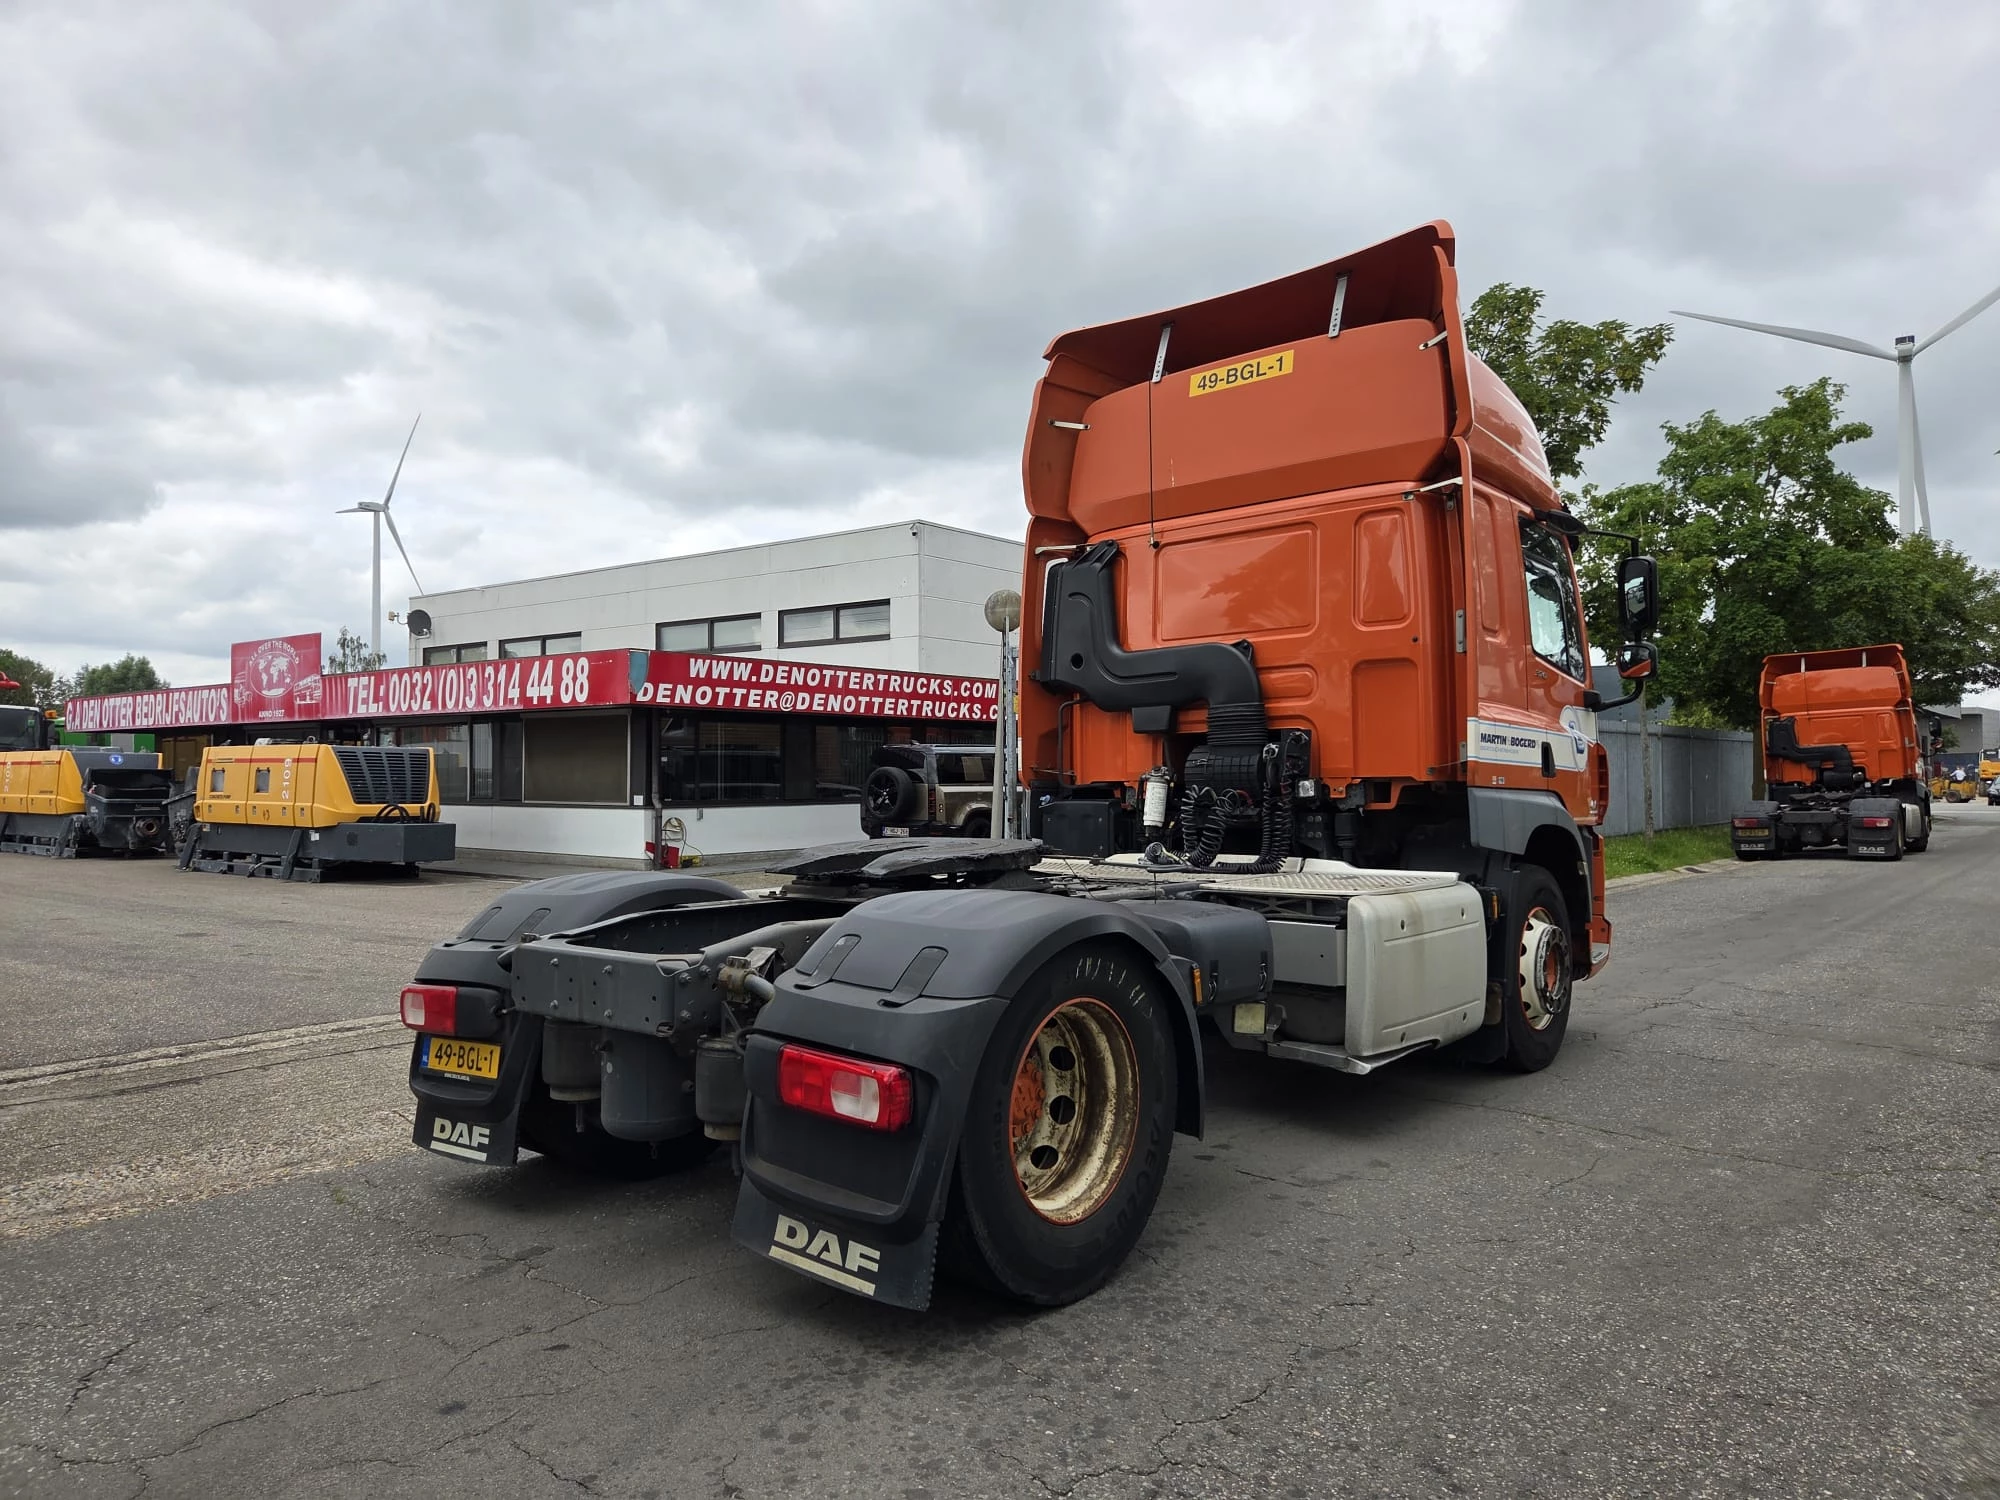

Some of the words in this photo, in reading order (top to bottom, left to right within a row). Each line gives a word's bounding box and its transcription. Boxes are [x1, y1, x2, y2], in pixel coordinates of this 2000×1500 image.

[1197, 355, 1284, 391] 49-BGL-1
[272, 640, 283, 650] THE
[347, 675, 384, 714] TEL:
[388, 671, 433, 713] 0032
[438, 666, 477, 712] (0)3
[482, 662, 521, 707] 314
[526, 659, 554, 705] 44
[560, 656, 590, 704] 88
[689, 658, 997, 699] WWW.DENOTTERTRUCKS.COM
[82, 698, 100, 729] DEN
[102, 695, 133, 728] OTTER
[135, 687, 228, 726] BEDRIJFSAUTO'S
[1480, 732, 1507, 746] MARTIN
[1510, 736, 1537, 749] BOGERD
[434, 1042, 495, 1073] 49-BGL-1
[433, 1116, 490, 1148] DAF
[773, 1213, 881, 1273] DAF
